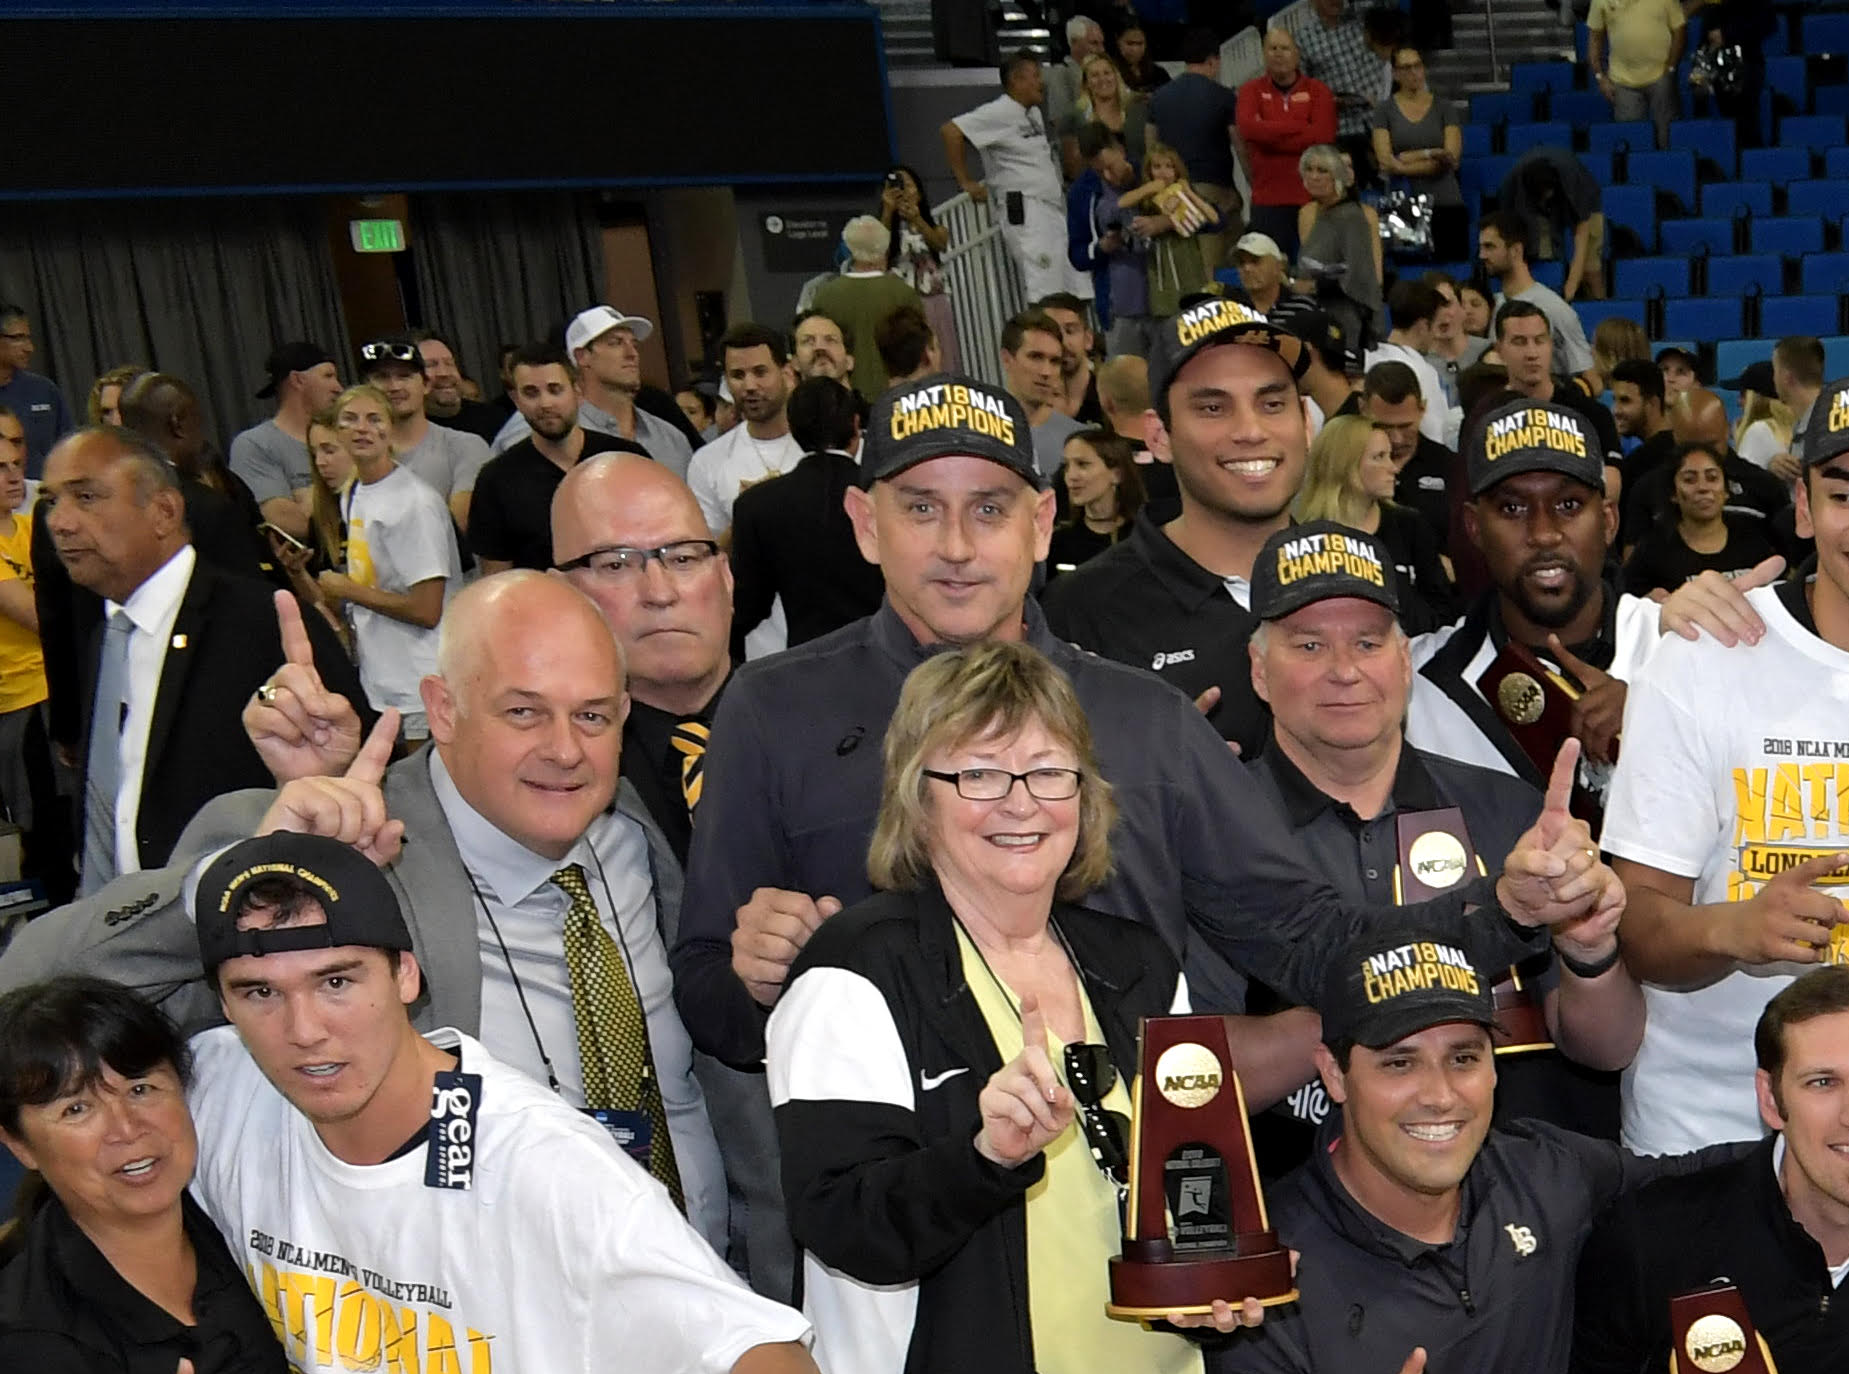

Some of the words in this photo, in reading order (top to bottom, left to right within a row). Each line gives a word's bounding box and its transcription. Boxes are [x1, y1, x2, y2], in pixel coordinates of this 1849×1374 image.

[1166, 649, 1195, 664] asics
[1763, 737, 1793, 755] 2018
[1366, 962, 1480, 1003] CHAMPIONS
[1163, 1074, 1220, 1092] NCAA
[431, 1086, 472, 1190] gear
[361, 1268, 453, 1310] VOLLEYBALL
[1693, 1339, 1743, 1361] NCAA
